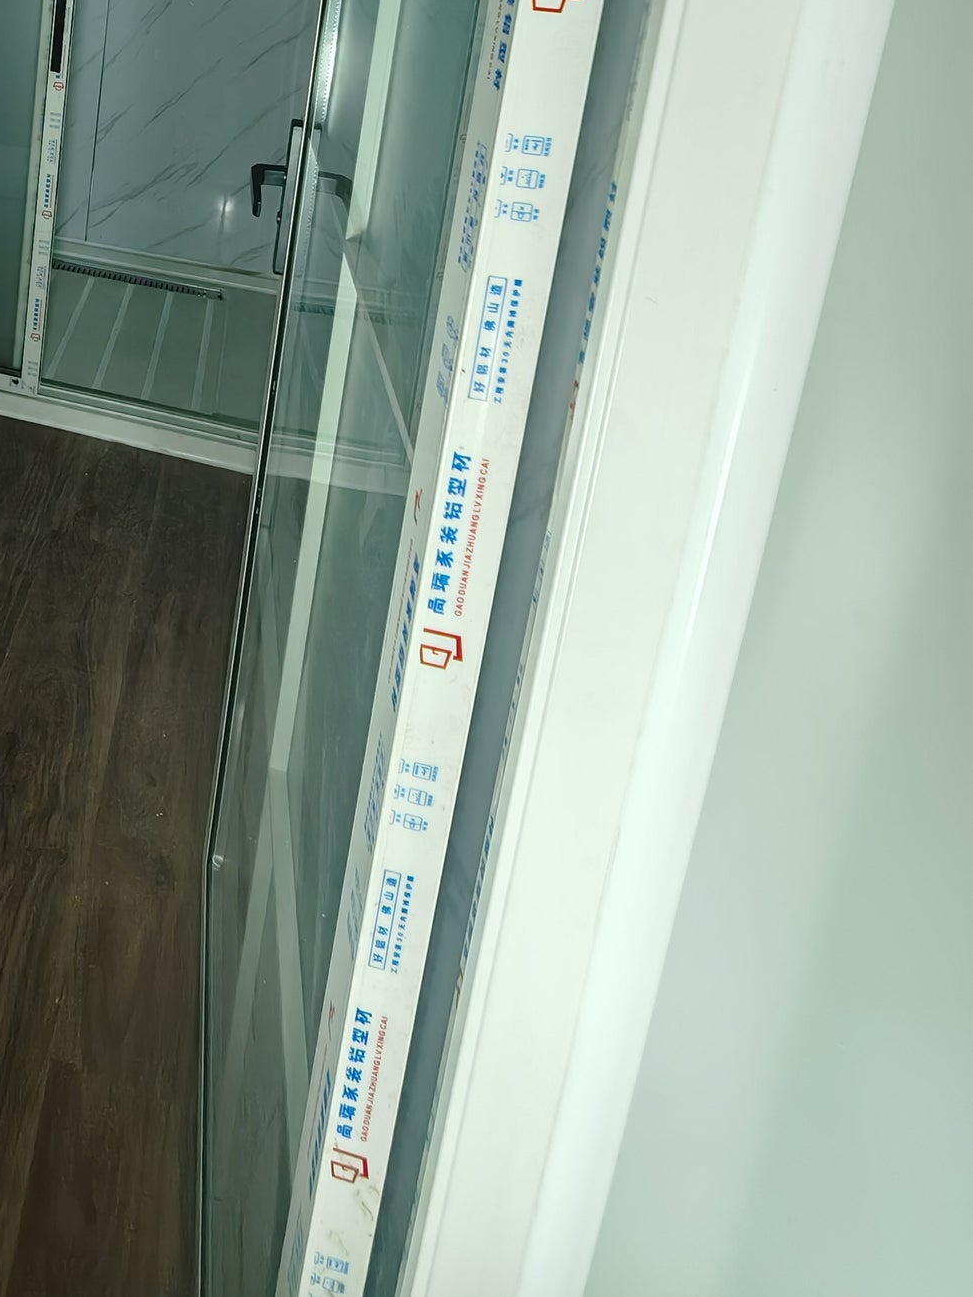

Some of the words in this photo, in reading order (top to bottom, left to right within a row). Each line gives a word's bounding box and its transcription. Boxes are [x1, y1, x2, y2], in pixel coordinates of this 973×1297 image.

[426, 451, 473, 616] 高端家装铝型材
[335, 1006, 373, 1140] 高端家装铝型材
